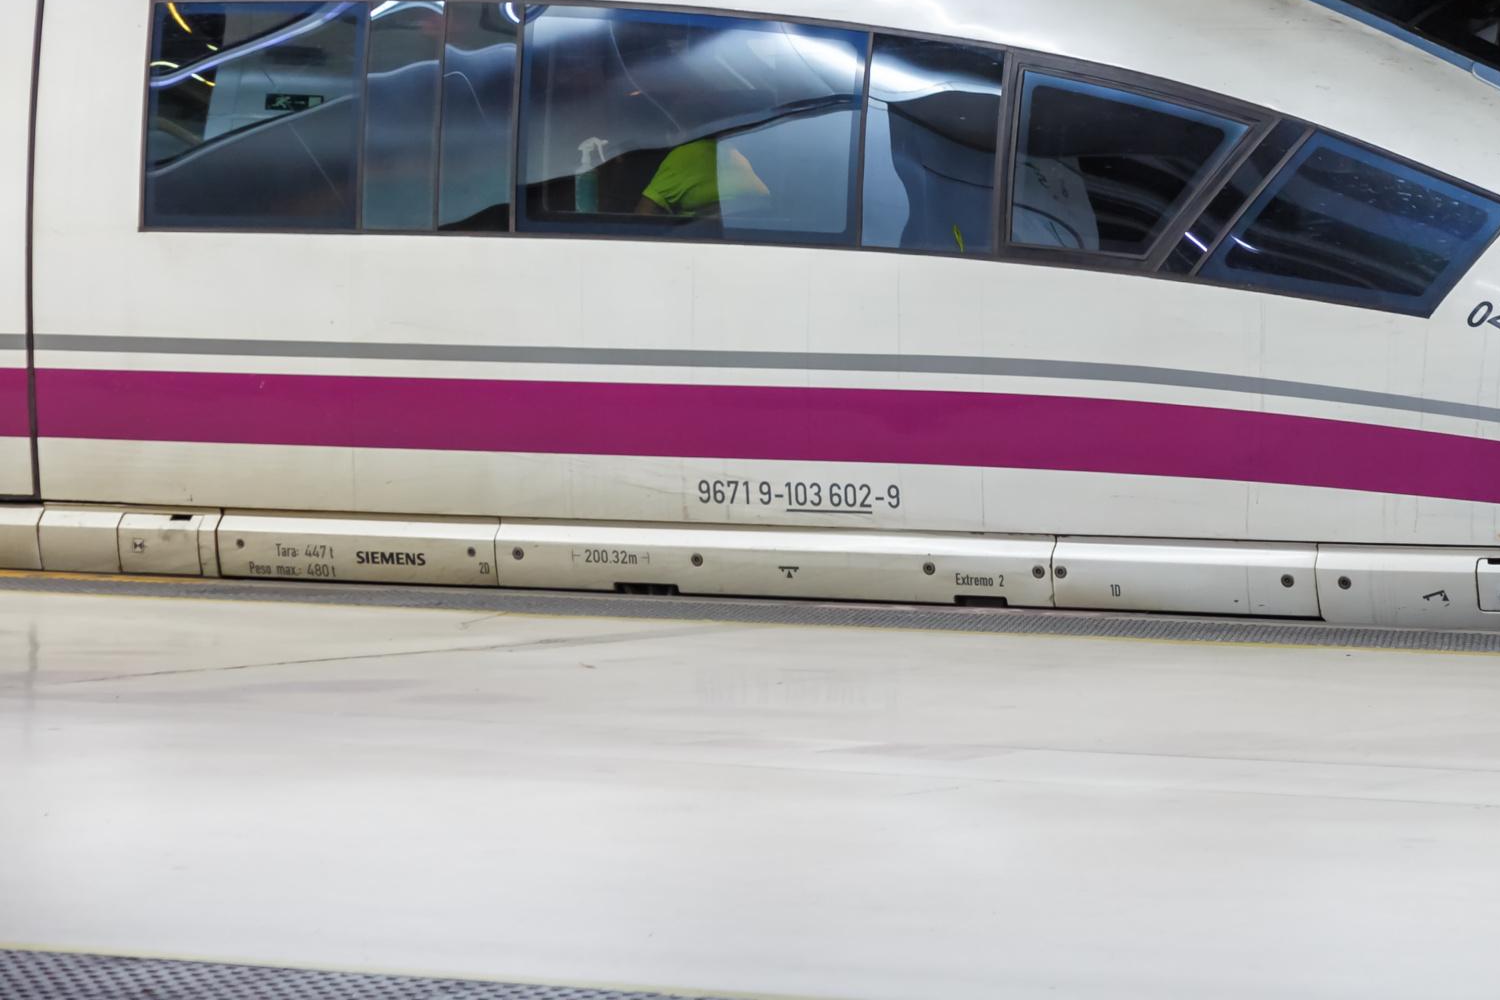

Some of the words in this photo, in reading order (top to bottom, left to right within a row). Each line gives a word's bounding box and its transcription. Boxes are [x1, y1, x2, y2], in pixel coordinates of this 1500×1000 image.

[698, 480, 750, 505] 9671
[356, 551, 426, 567] SIEMENS
[584, 549, 638, 565] 200.32m
[249, 561, 272, 575] Peso
[307, 563, 330, 578] 480
[955, 573, 994, 587] Extremo
[998, 574, 1005, 587] 2
